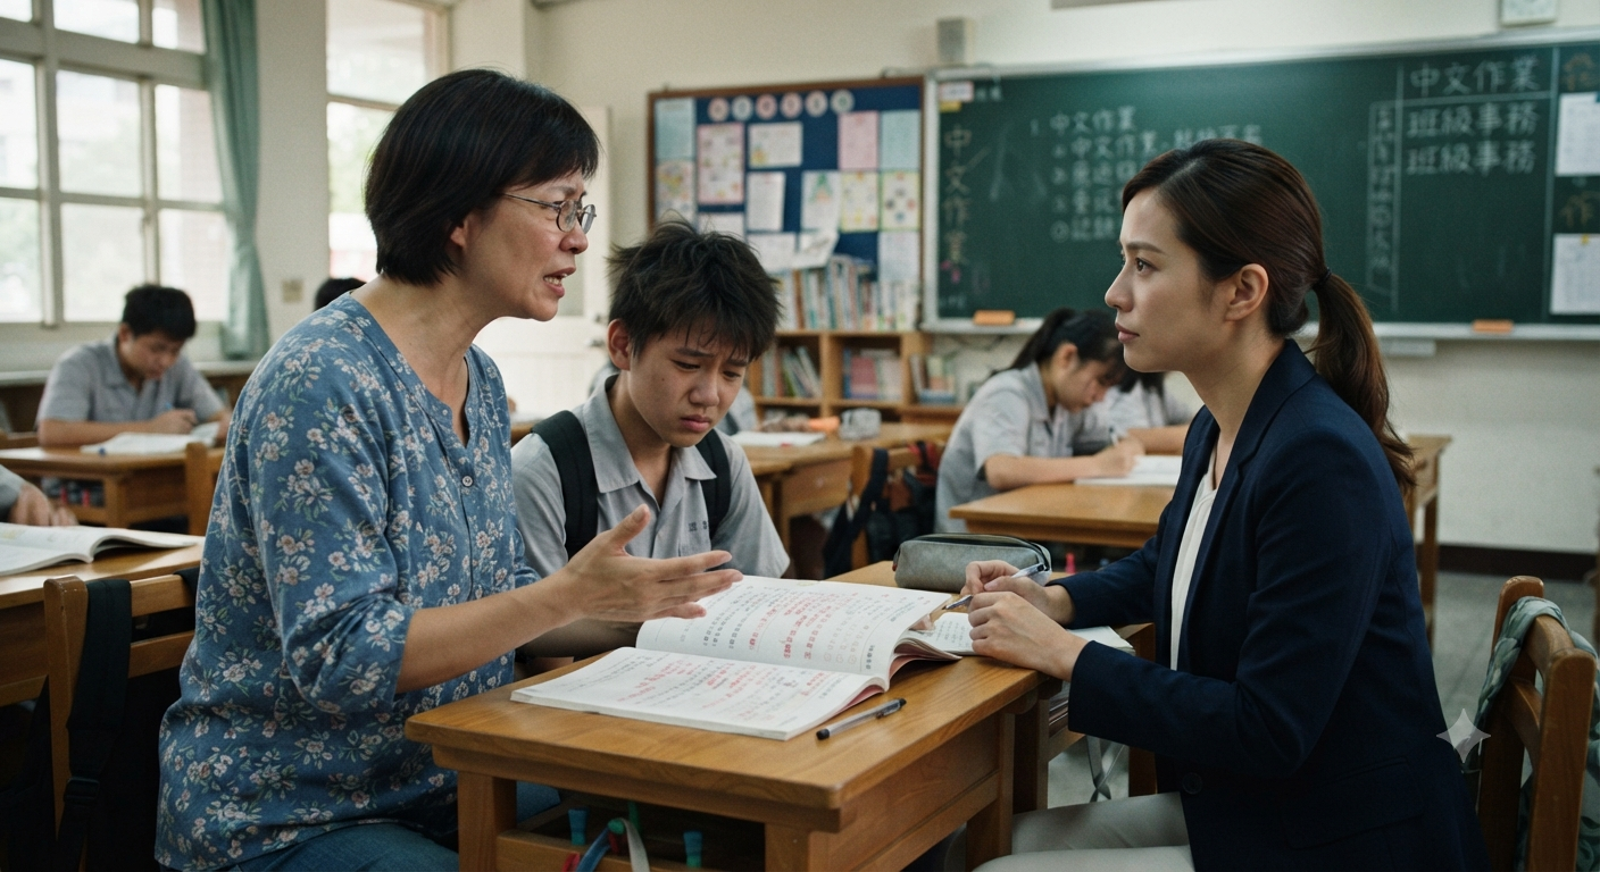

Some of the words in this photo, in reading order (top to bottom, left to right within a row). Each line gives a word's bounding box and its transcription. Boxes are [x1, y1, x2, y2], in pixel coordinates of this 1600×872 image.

[1410, 54, 1541, 97] 中文作業
[1406, 101, 1540, 138] 班級事務
[1406, 139, 1537, 177] 班級事務
